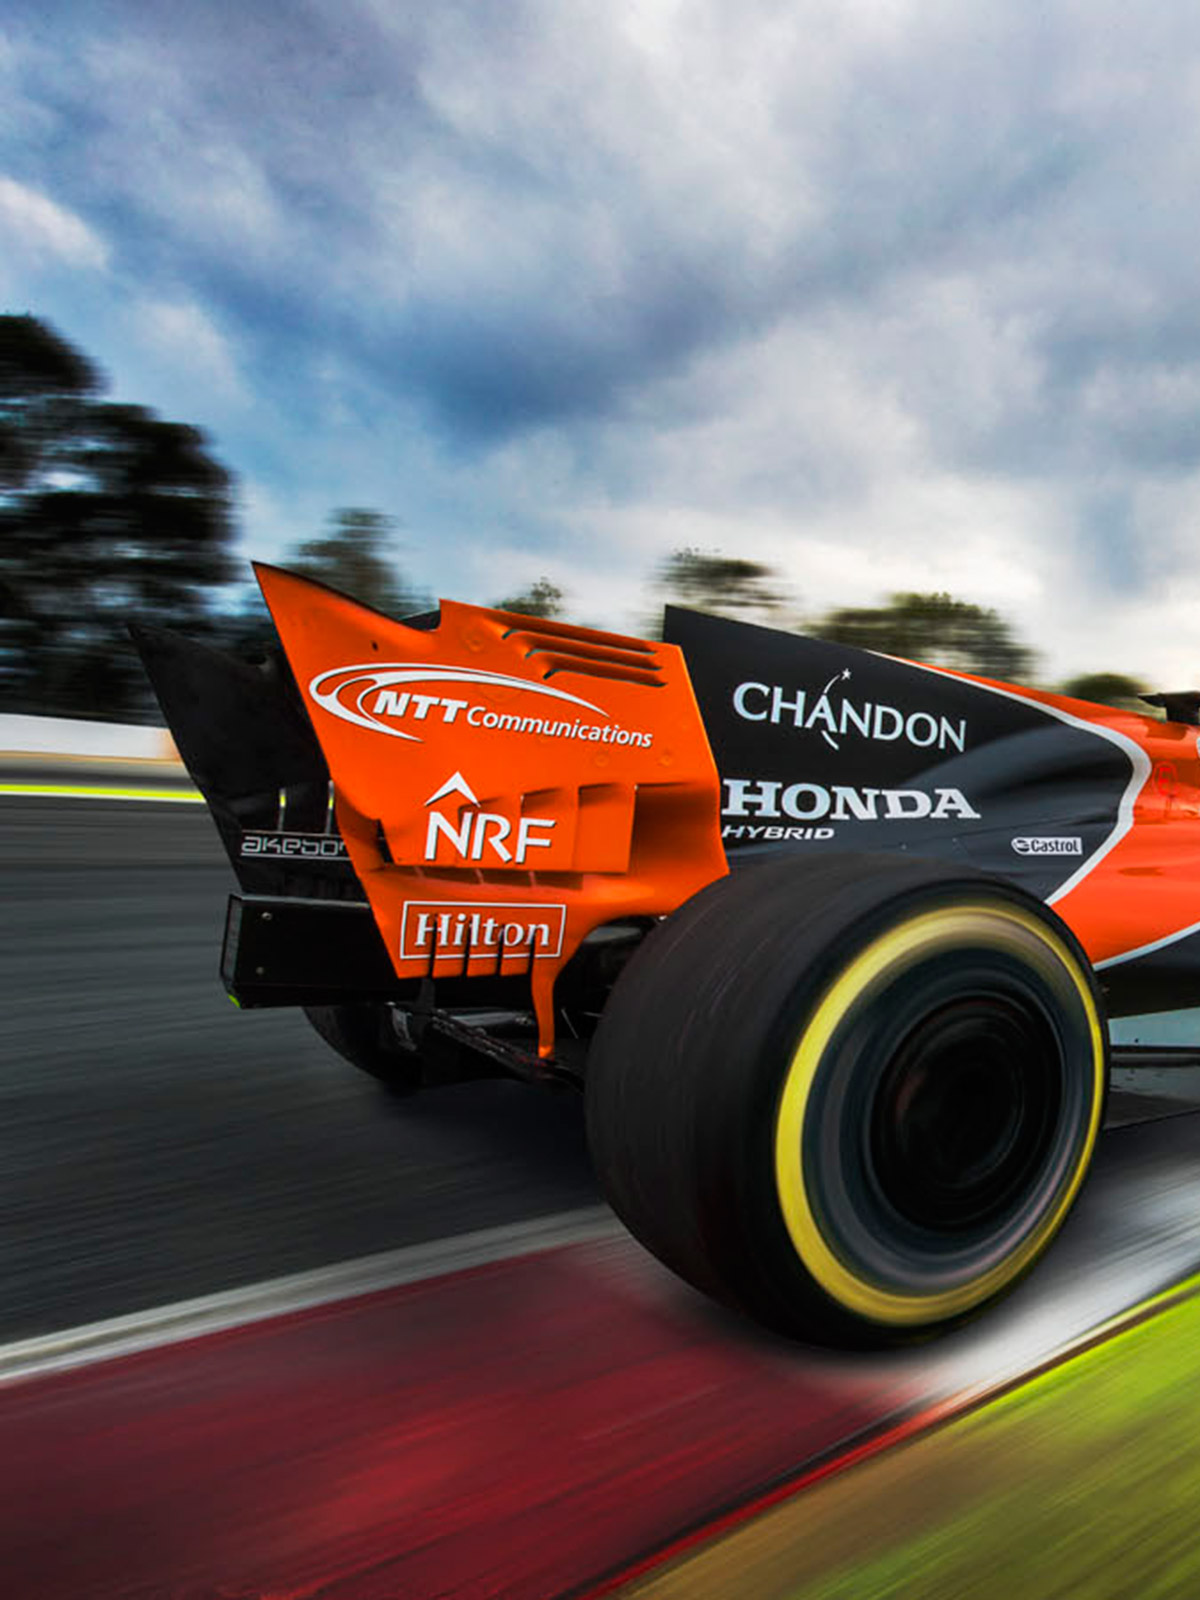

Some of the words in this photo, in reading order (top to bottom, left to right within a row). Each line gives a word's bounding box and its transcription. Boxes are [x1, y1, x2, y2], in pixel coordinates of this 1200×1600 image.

[373, 690, 467, 722] NTT
[466, 706, 652, 747] Communications
[733, 682, 966, 752] CHANDON
[721, 778, 981, 820] HONDA
[424, 811, 556, 864] NRF
[721, 825, 834, 840] HYBRID
[1031, 839, 1079, 853] Castrol
[414, 913, 551, 946] Hilton
